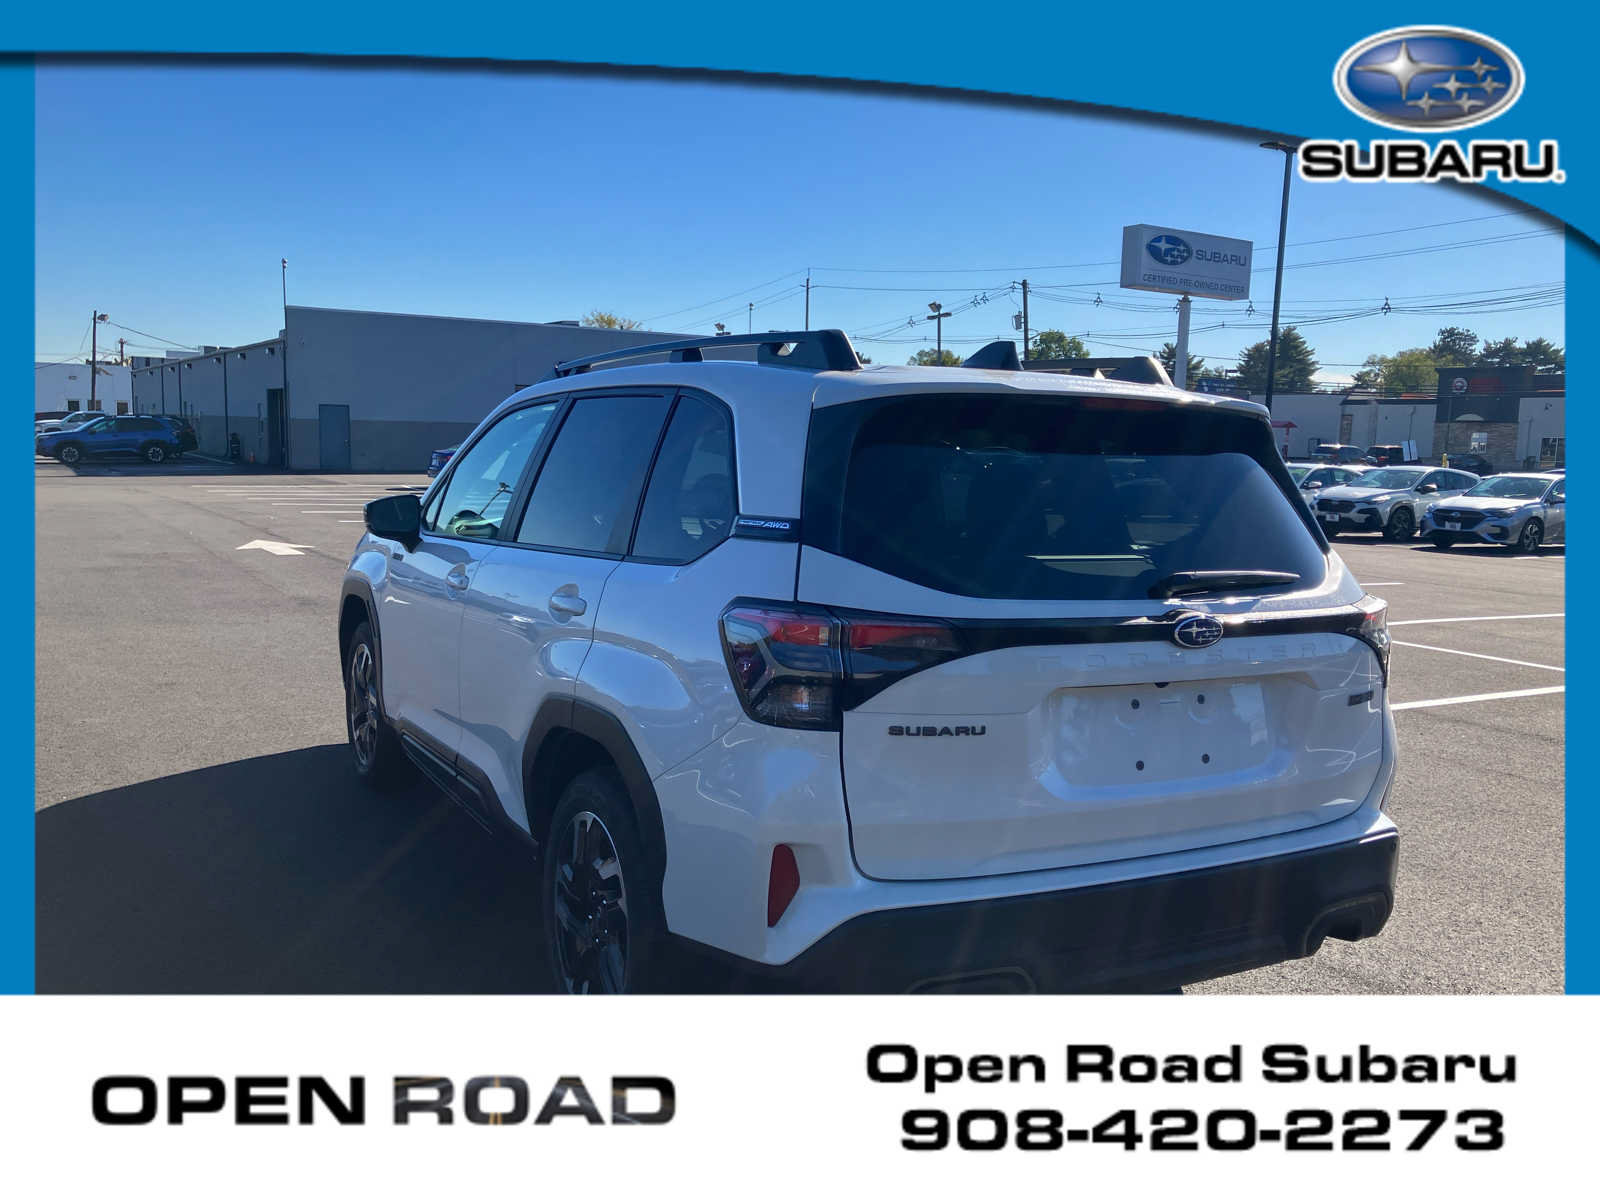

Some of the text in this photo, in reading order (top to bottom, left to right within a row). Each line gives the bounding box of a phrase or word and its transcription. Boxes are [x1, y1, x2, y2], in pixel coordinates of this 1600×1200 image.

[1194, 250, 1247, 267] SUBARU
[1143, 272, 1178, 286] CERTIFIED
[1220, 283, 1245, 294] CENTER
[887, 725, 986, 737] SUBARU
